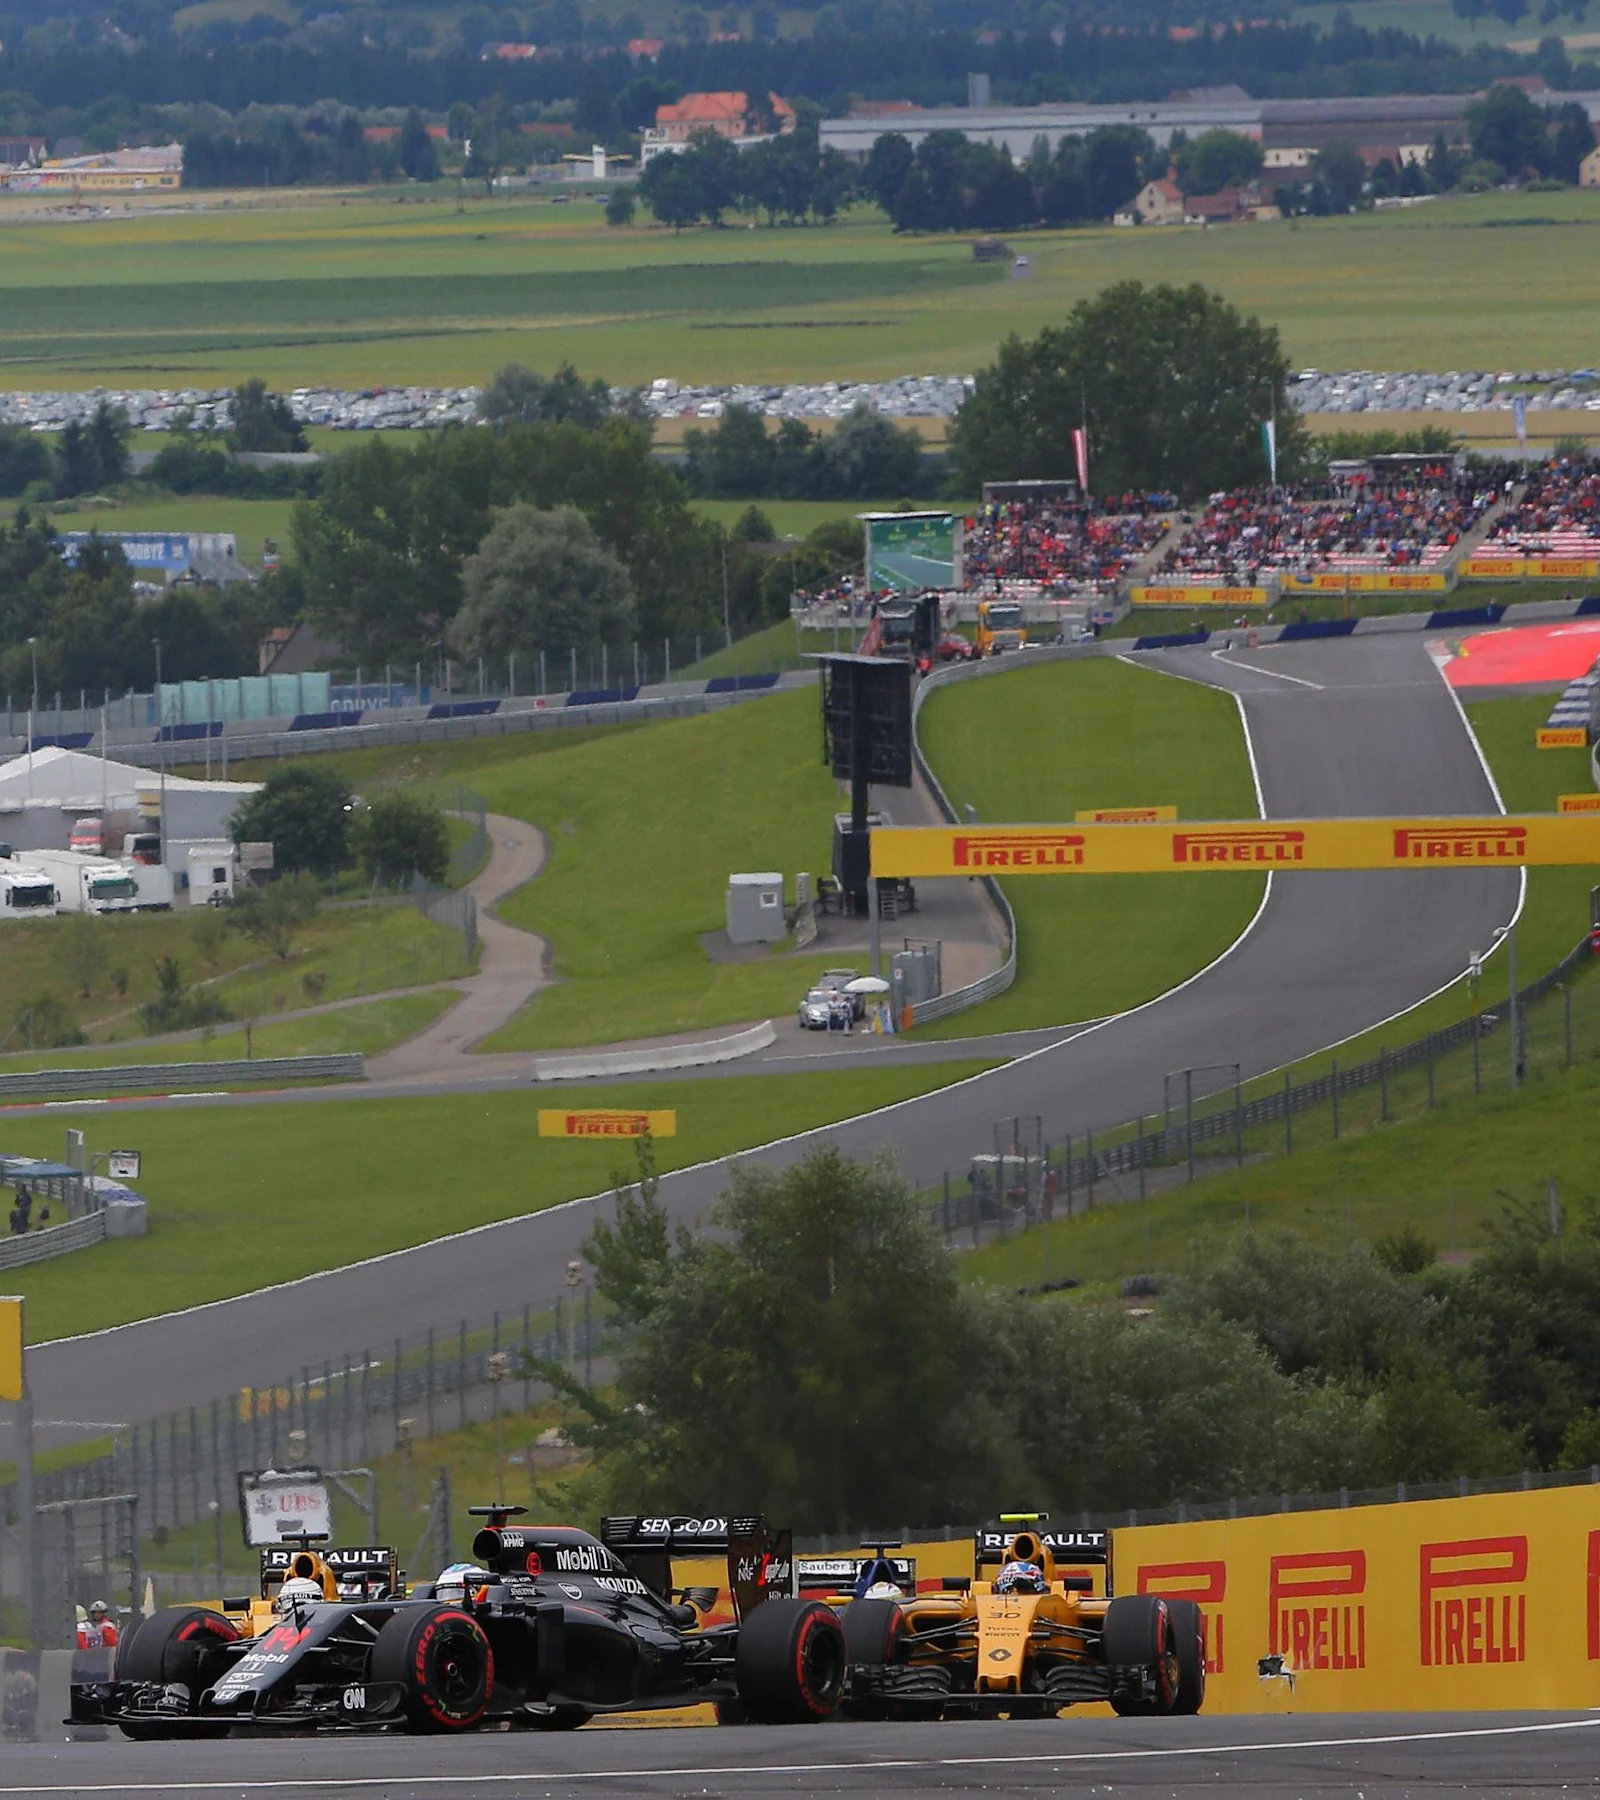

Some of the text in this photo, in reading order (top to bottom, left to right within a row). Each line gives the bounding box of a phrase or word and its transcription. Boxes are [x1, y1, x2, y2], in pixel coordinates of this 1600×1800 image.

[954, 826, 1528, 866] PIRELLI PIRELLI PIRELLI
[501, 1532, 524, 1548] KPMG
[984, 1533, 1104, 1547] REAULT
[556, 1546, 598, 1571] Mobil
[801, 1561, 846, 1571] Sauber
[593, 1576, 648, 1595] HONDA
[1269, 1549, 1366, 1671] PIRELLI
[1420, 1536, 1528, 1667] PIRELLI
[263, 1626, 313, 1653] 14
[240, 1651, 290, 1664] Mobil
[343, 1687, 366, 1710] CNN
